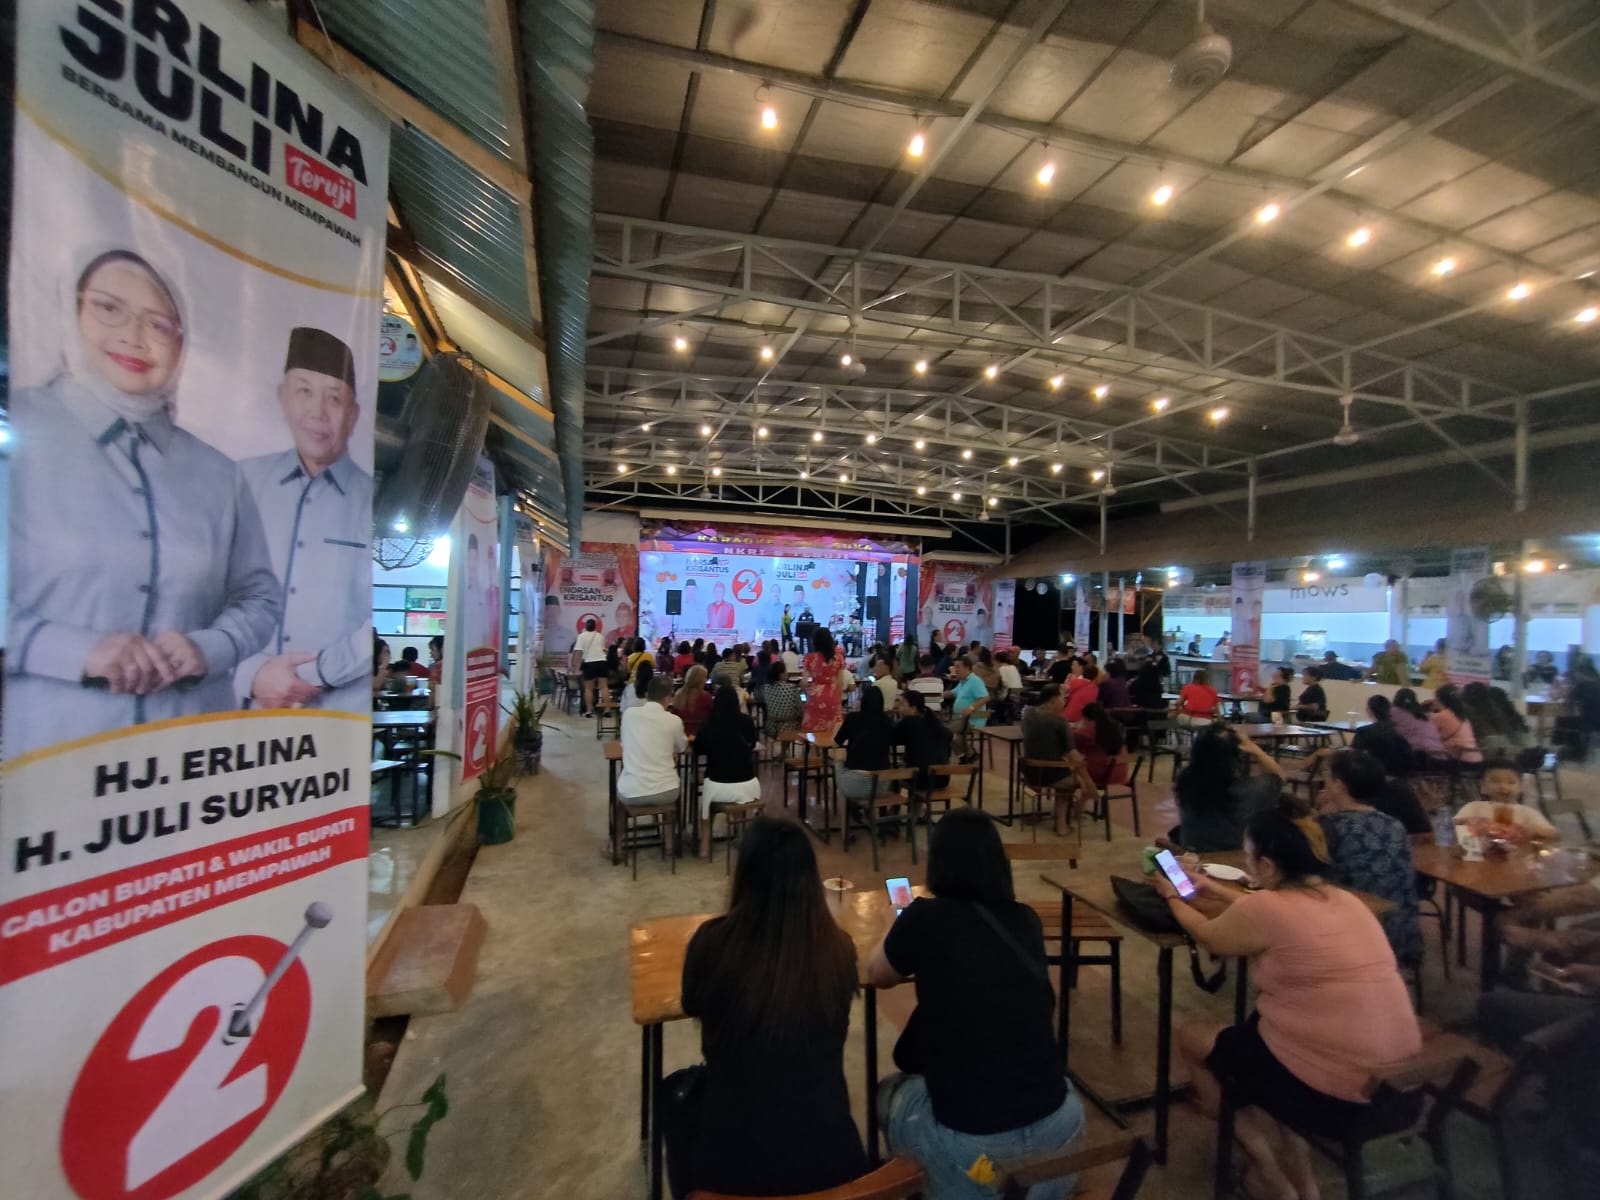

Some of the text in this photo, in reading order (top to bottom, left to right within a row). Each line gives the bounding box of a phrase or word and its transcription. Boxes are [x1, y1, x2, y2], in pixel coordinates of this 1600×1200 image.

[59, 4, 272, 176] JULI
[61, 63, 362, 247] BERSAMA MEMBANGUN MEMPAWAH
[288, 155, 355, 210] Teruji
[564, 594, 614, 602] KRISANTUS
[938, 603, 961, 612] JULI
[95, 733, 318, 798] HJ. ERLINA
[15, 767, 350, 873] H. JULI SURYADI
[1, 817, 355, 938] CALON BUPATI & WAKIL BUPATI
[47, 846, 331, 953] KABUPATEN MEMPAWAH
[124, 954, 269, 1192] 2
